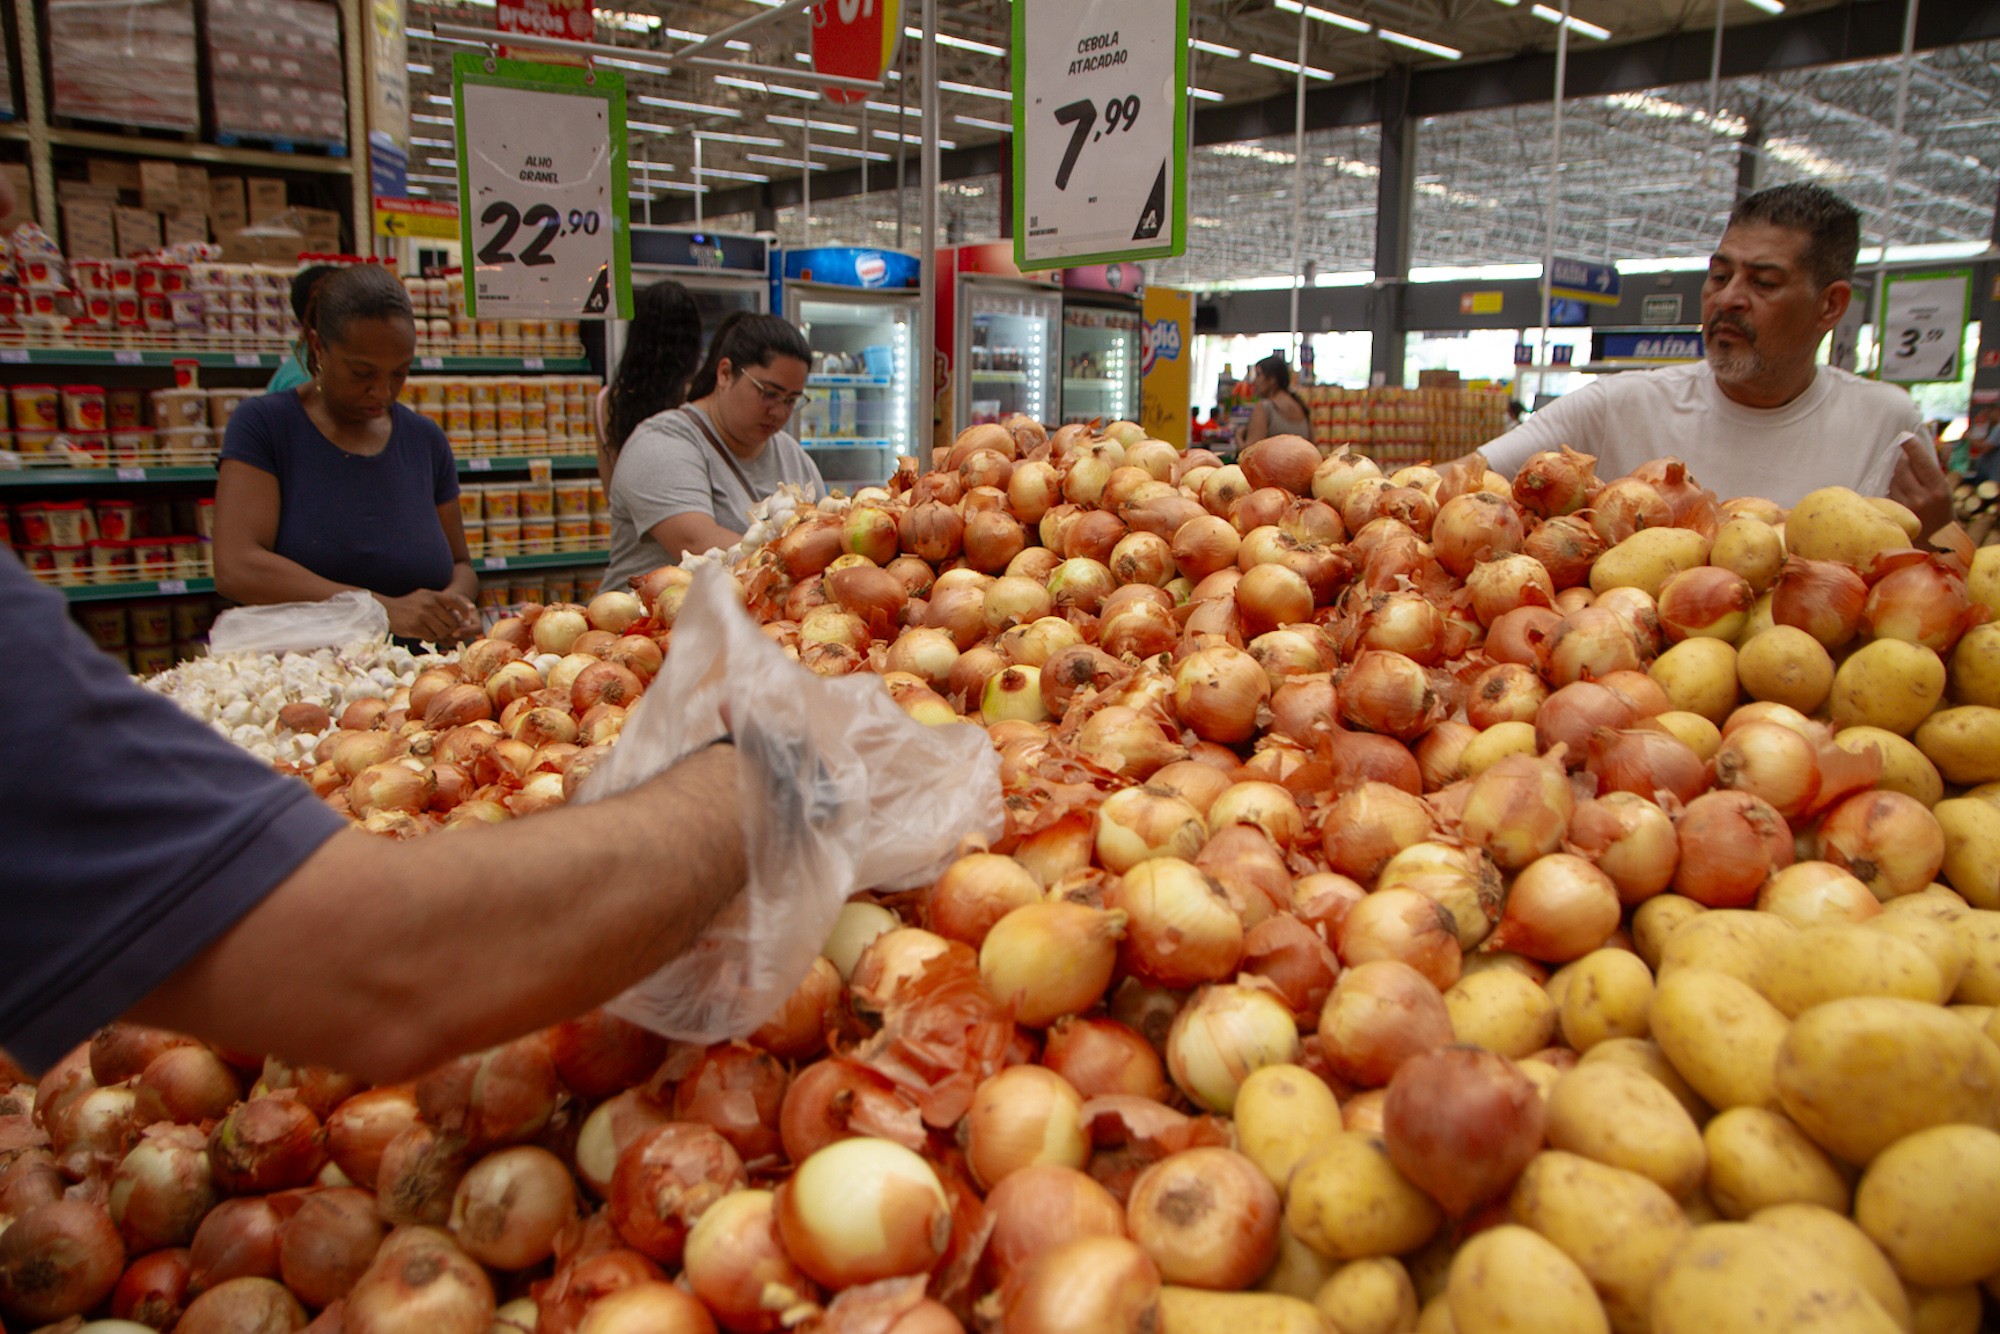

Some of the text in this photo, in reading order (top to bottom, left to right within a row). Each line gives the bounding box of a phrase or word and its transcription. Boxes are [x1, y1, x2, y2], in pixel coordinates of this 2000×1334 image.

[1077, 31, 1119, 54] CEBOLA
[1068, 49, 1128, 76] ATACADAO
[1053, 94, 1141, 191] 7,99
[525, 155, 553, 168] ALHO
[519, 170, 559, 184] GRANEL
[477, 201, 599, 266] 22,90
[1633, 336, 1698, 357] SAÍDA
